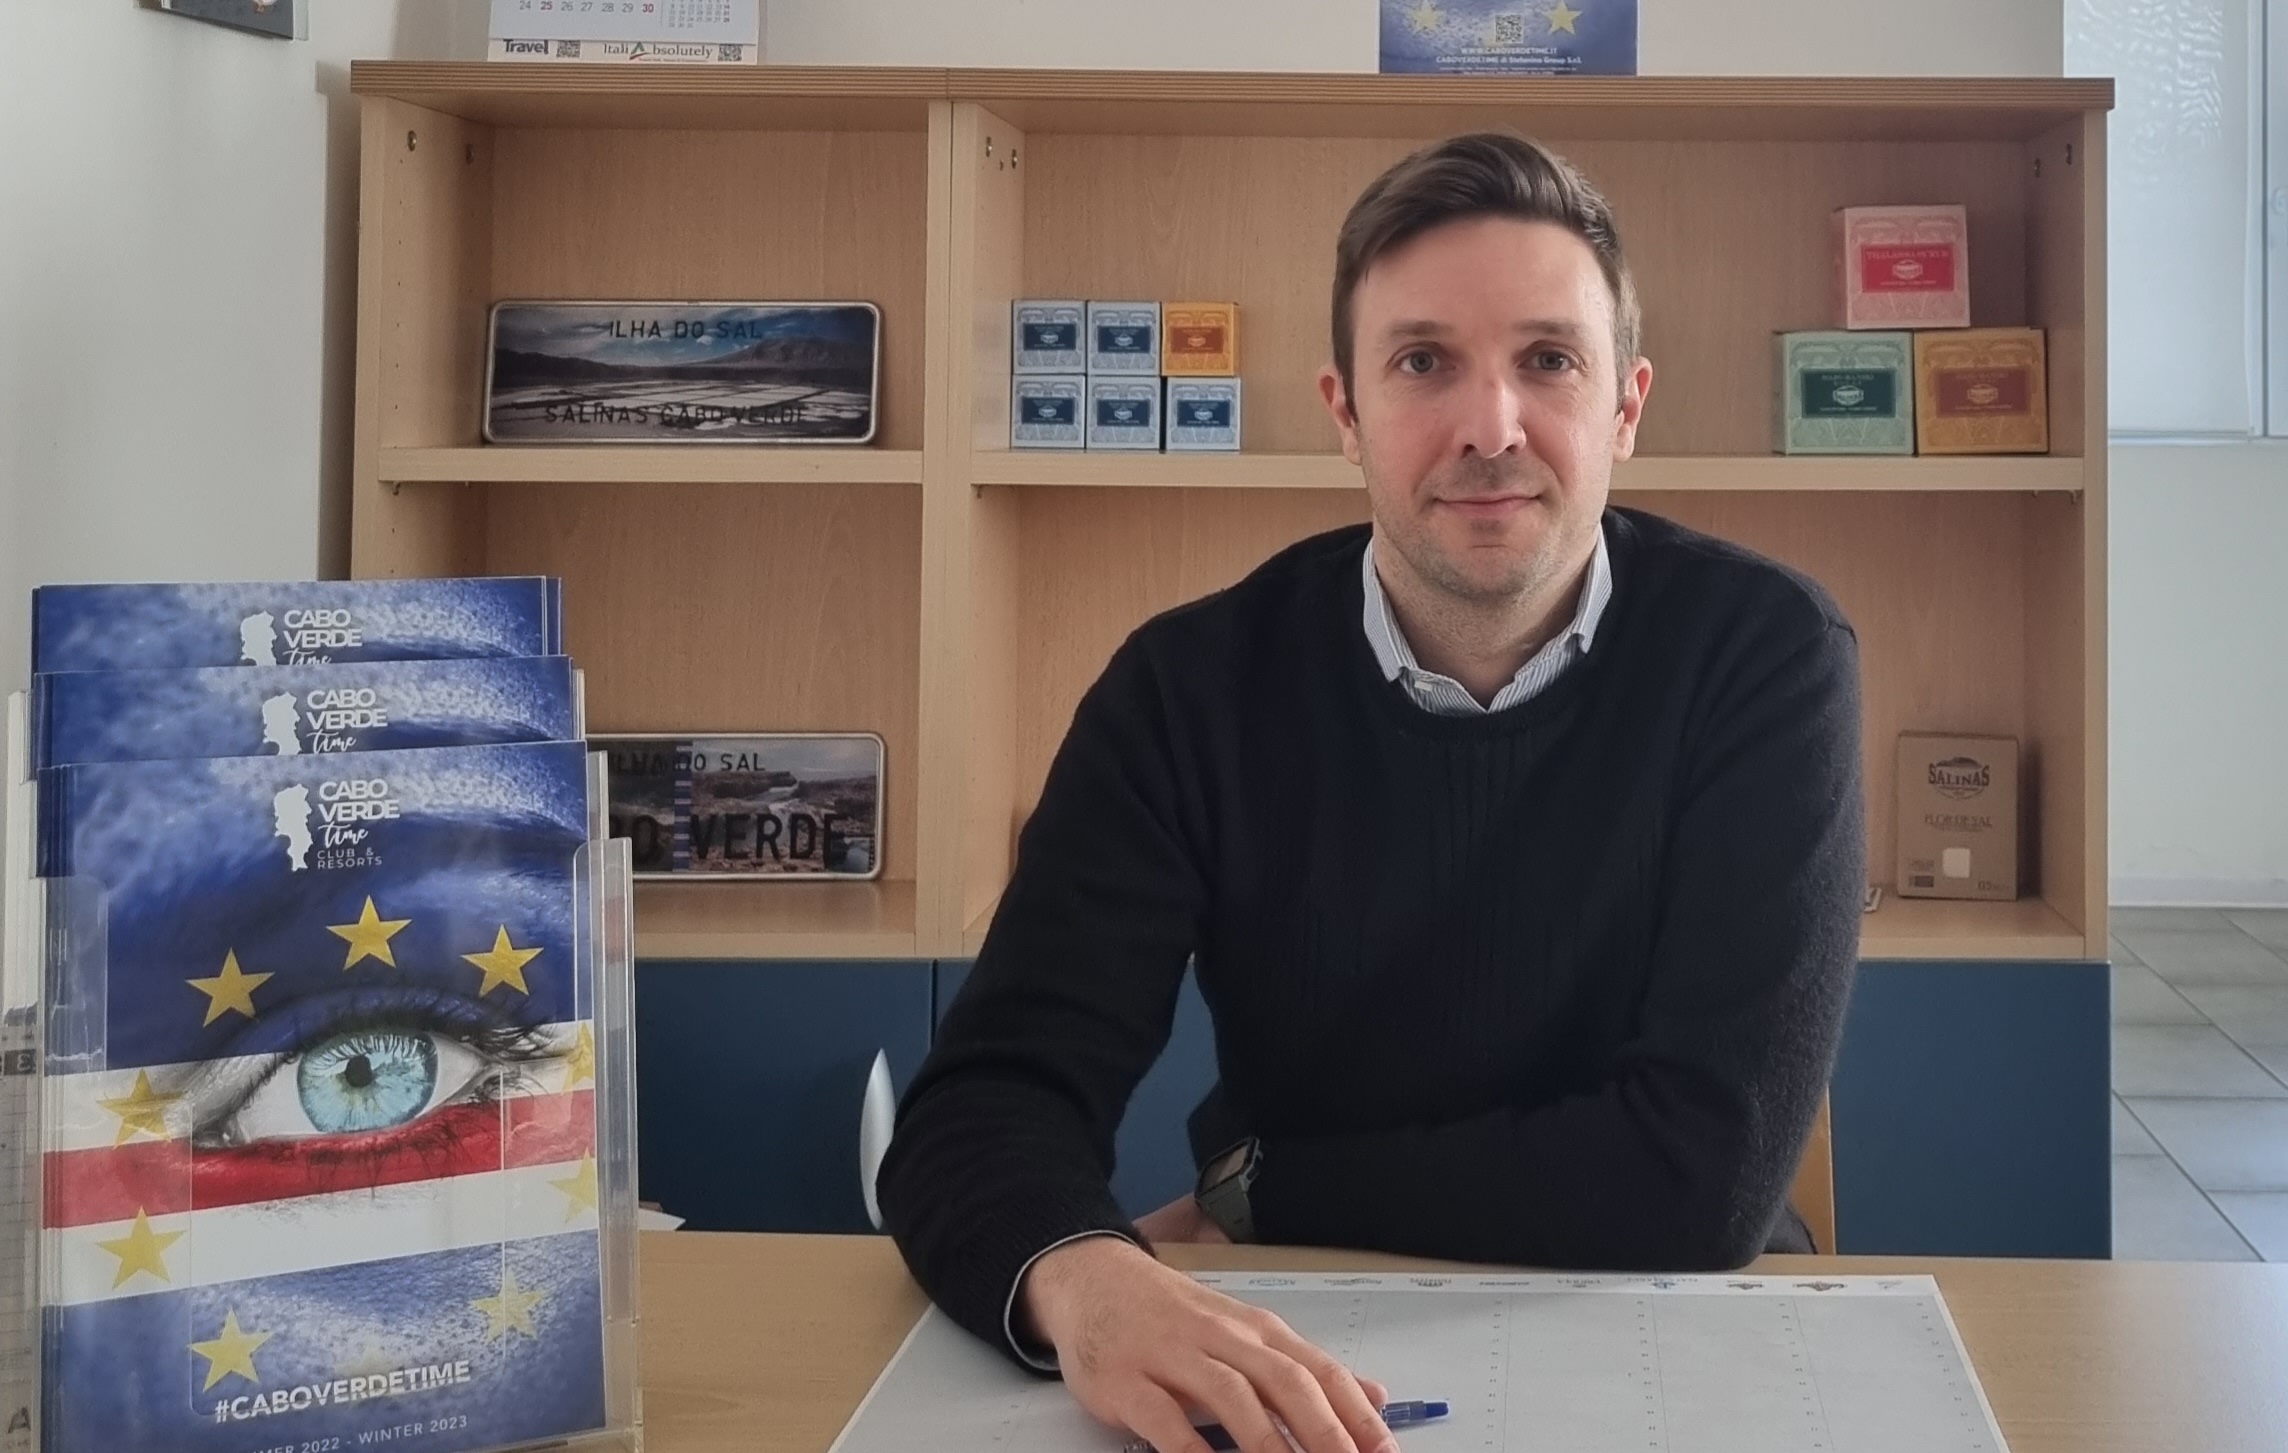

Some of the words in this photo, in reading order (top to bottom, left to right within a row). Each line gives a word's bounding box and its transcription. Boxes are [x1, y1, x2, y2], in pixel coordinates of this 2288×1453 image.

[519, 1, 531, 10] 24
[540, 1, 553, 11] 25
[561, 2, 573, 11] 26
[580, 2, 593, 12] 27
[601, 3, 614, 12] 28
[621, 3, 633, 13] 29
[642, 4, 655, 13] 30
[503, 39, 548, 54] Travel
[609, 320, 662, 338] ILHA
[675, 320, 704, 338] DO
[716, 320, 762, 339] SAL
[544, 404, 648, 424] SALINAS
[660, 404, 724, 424] CABO
[284, 608, 351, 629] CABO
[283, 628, 363, 649] VERDE
[306, 688, 376, 710] CABO
[306, 708, 388, 730] VERDE
[720, 753, 766, 772] SAL
[1928, 763, 1990, 786] SALINAS
[319, 778, 389, 801] CABO
[318, 799, 400, 822] VERDE
[690, 812, 850, 868] VERDE
[317, 848, 355, 860] CLUB
[366, 847, 374, 856] &
[317, 856, 383, 870] RESORTS
[214, 1360, 472, 1423] #CABOVERDETIME
[301, 1437, 341, 1453] 2022
[358, 1423, 423, 1445] WINTER
[430, 1416, 468, 1433] 2023
